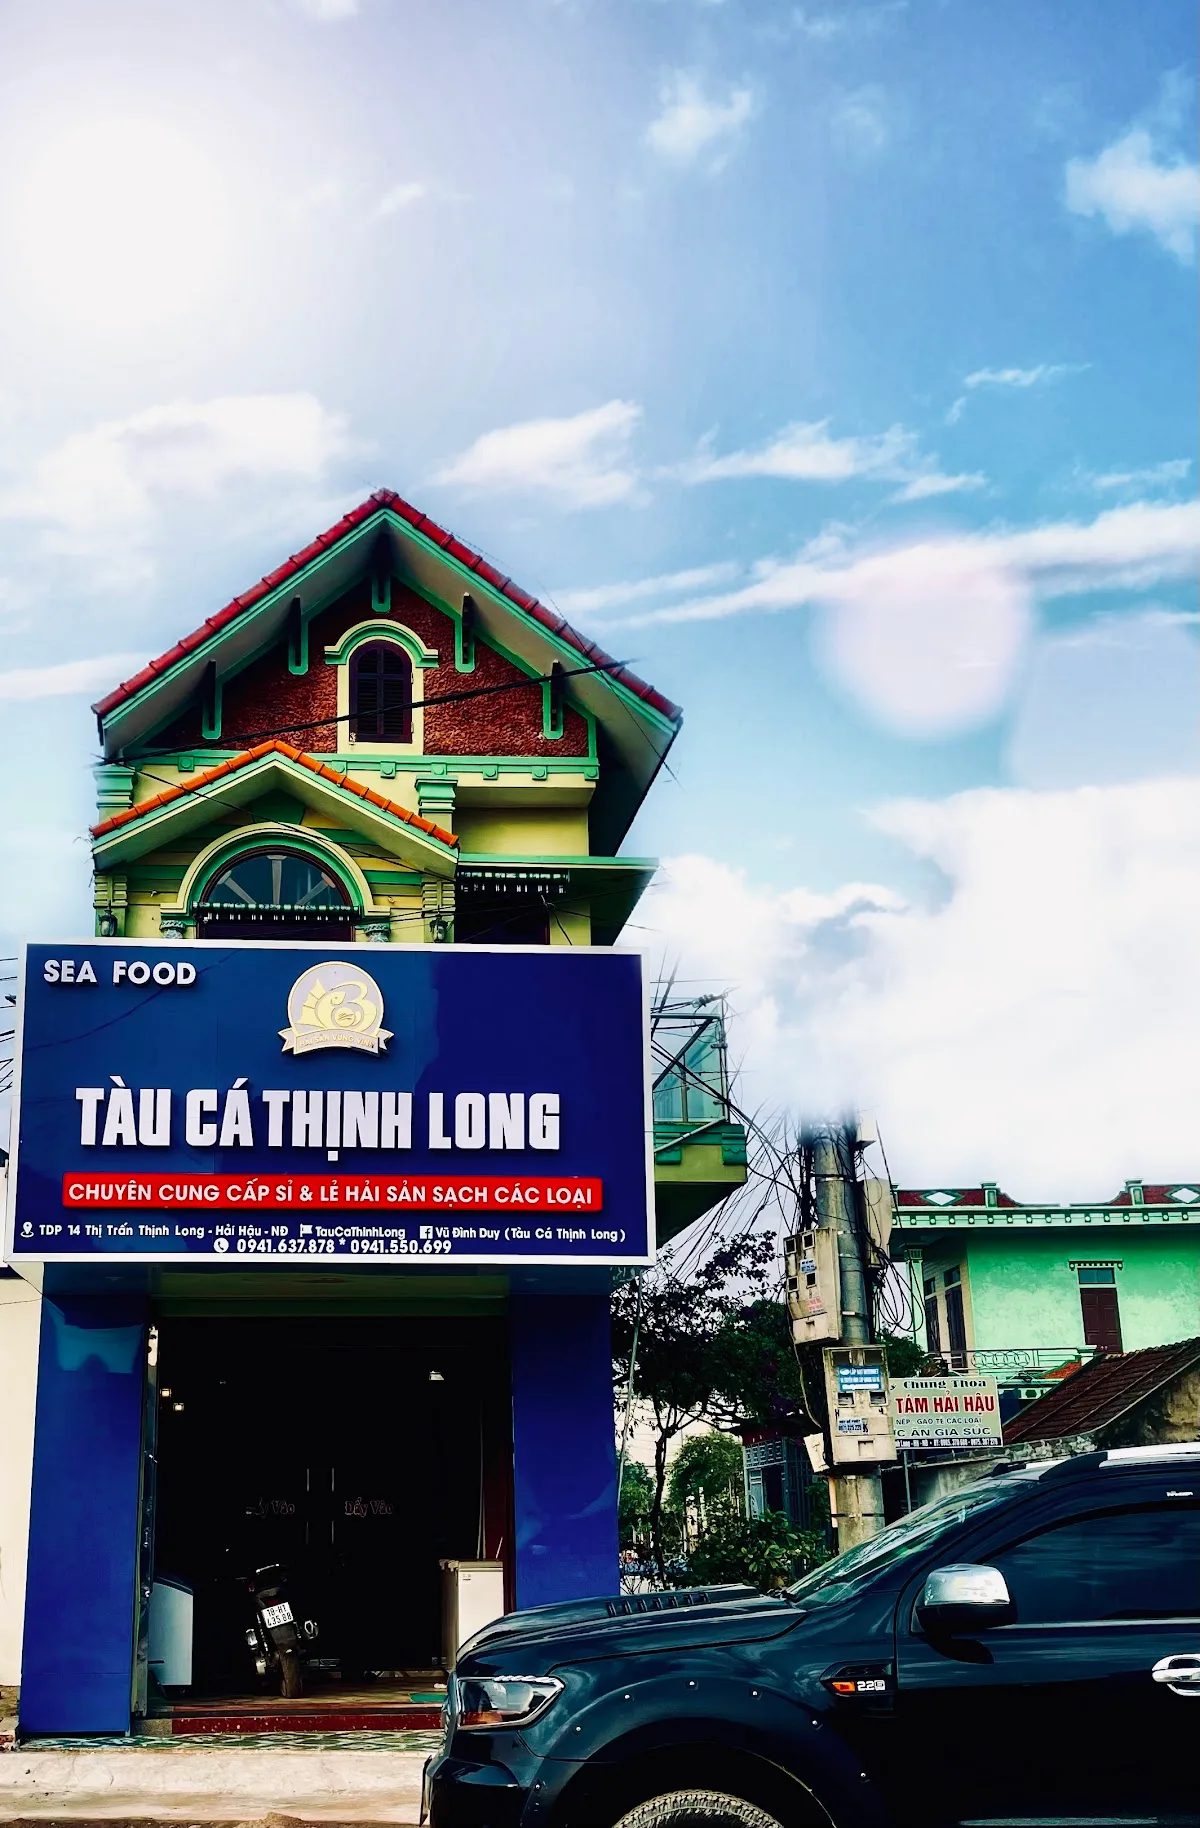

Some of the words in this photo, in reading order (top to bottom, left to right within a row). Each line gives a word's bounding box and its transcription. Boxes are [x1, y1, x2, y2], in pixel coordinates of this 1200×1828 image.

[43, 960, 97, 983] SEA
[113, 961, 197, 985] FOOD
[76, 1076, 172, 1146] TÀU
[185, 1078, 254, 1147] CÁ
[262, 1090, 412, 1161] THỊNH
[428, 1092, 560, 1150] LONG
[68, 1180, 152, 1201] CHUYÊN
[158, 1184, 220, 1202] CUNG
[226, 1178, 270, 1202] CẤP
[276, 1180, 293, 1202] SỈ
[300, 1185, 313, 1202] &
[320, 1180, 339, 1202] LẺ
[346, 1180, 380, 1202] HẢI
[387, 1180, 426, 1203] SẢN
[432, 1186, 488, 1208] SẠCH
[494, 1183, 540, 1204] CÁC
[547, 1188, 592, 1209] LOẠI
[39, 1225, 63, 1236] TDP
[67, 1225, 81, 1236] 14
[85, 1225, 102, 1238] Thị
[107, 1222, 134, 1236] Trấn
[138, 1225, 170, 1238] Thịnh
[175, 1225, 205, 1239] Long
[215, 1223, 235, 1236] Hải
[238, 1225, 262, 1239] Hậu
[271, 1226, 289, 1237] NĐ
[435, 1227, 450, 1238] Vũ
[452, 1225, 477, 1238] Đình
[479, 1228, 500, 1241] Duy
[535, 1227, 553, 1239] Cá
[556, 1228, 586, 1242] Thịnh
[236, 1239, 335, 1253] 0941.637.878
[350, 1240, 452, 1254] 0941.550.699
[903, 1380, 947, 1389] Chung
[951, 1379, 987, 1388] Thoa
[895, 1394, 929, 1414] TÁM
[933, 1390, 959, 1413] HẢI
[963, 1392, 995, 1415] HẬU
[934, 1428, 959, 1436] GIA
